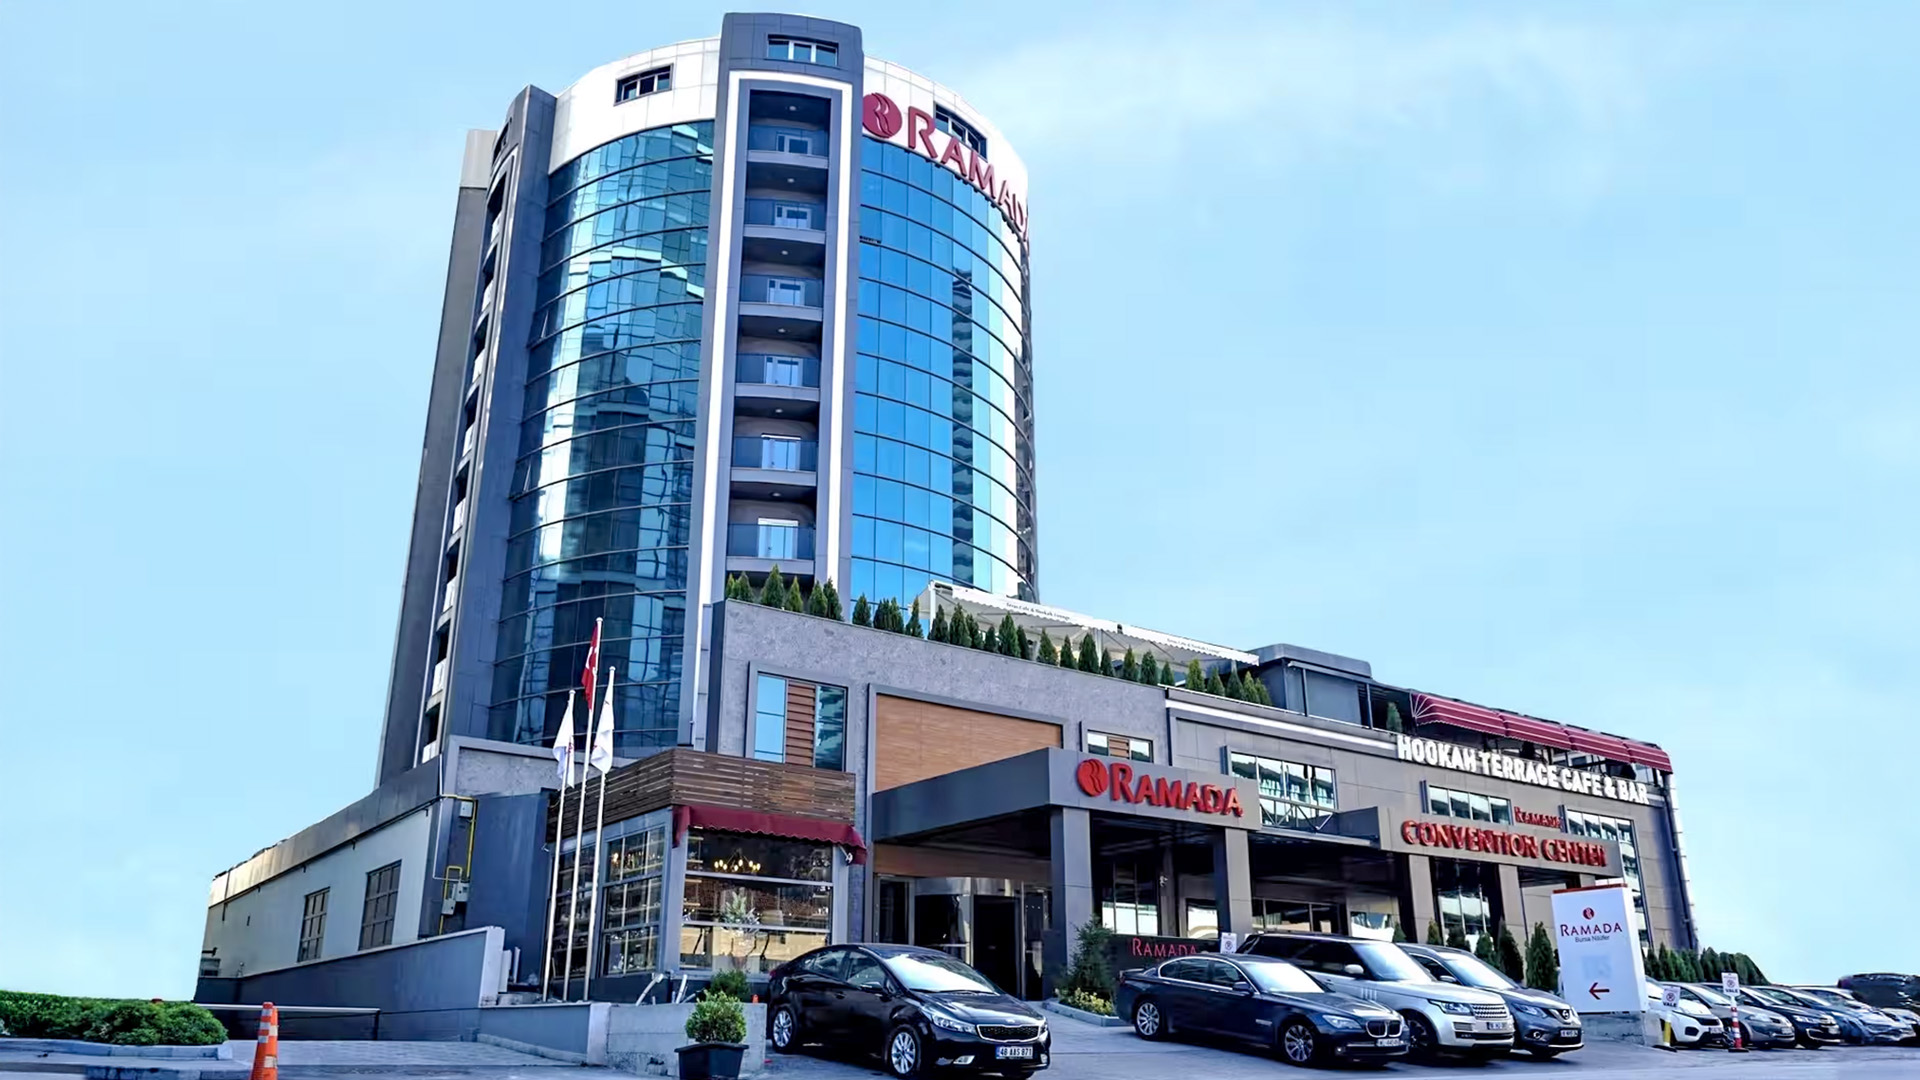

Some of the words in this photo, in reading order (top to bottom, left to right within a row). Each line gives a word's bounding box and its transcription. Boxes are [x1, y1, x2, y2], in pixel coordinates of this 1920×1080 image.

[1109, 762, 1244, 817] RAMADA
[1397, 734, 1477, 773] HOOKAH
[1478, 751, 1559, 788] TERRACE
[1561, 768, 1603, 797] CAFE
[1604, 776, 1618, 799] &
[1617, 780, 1650, 805] BAR
[1401, 820, 1539, 859] CONVENTION
[1541, 839, 1607, 867] CENTER
[1132, 937, 1197, 957] RAMADA
[1560, 922, 1623, 937] RAMADA
